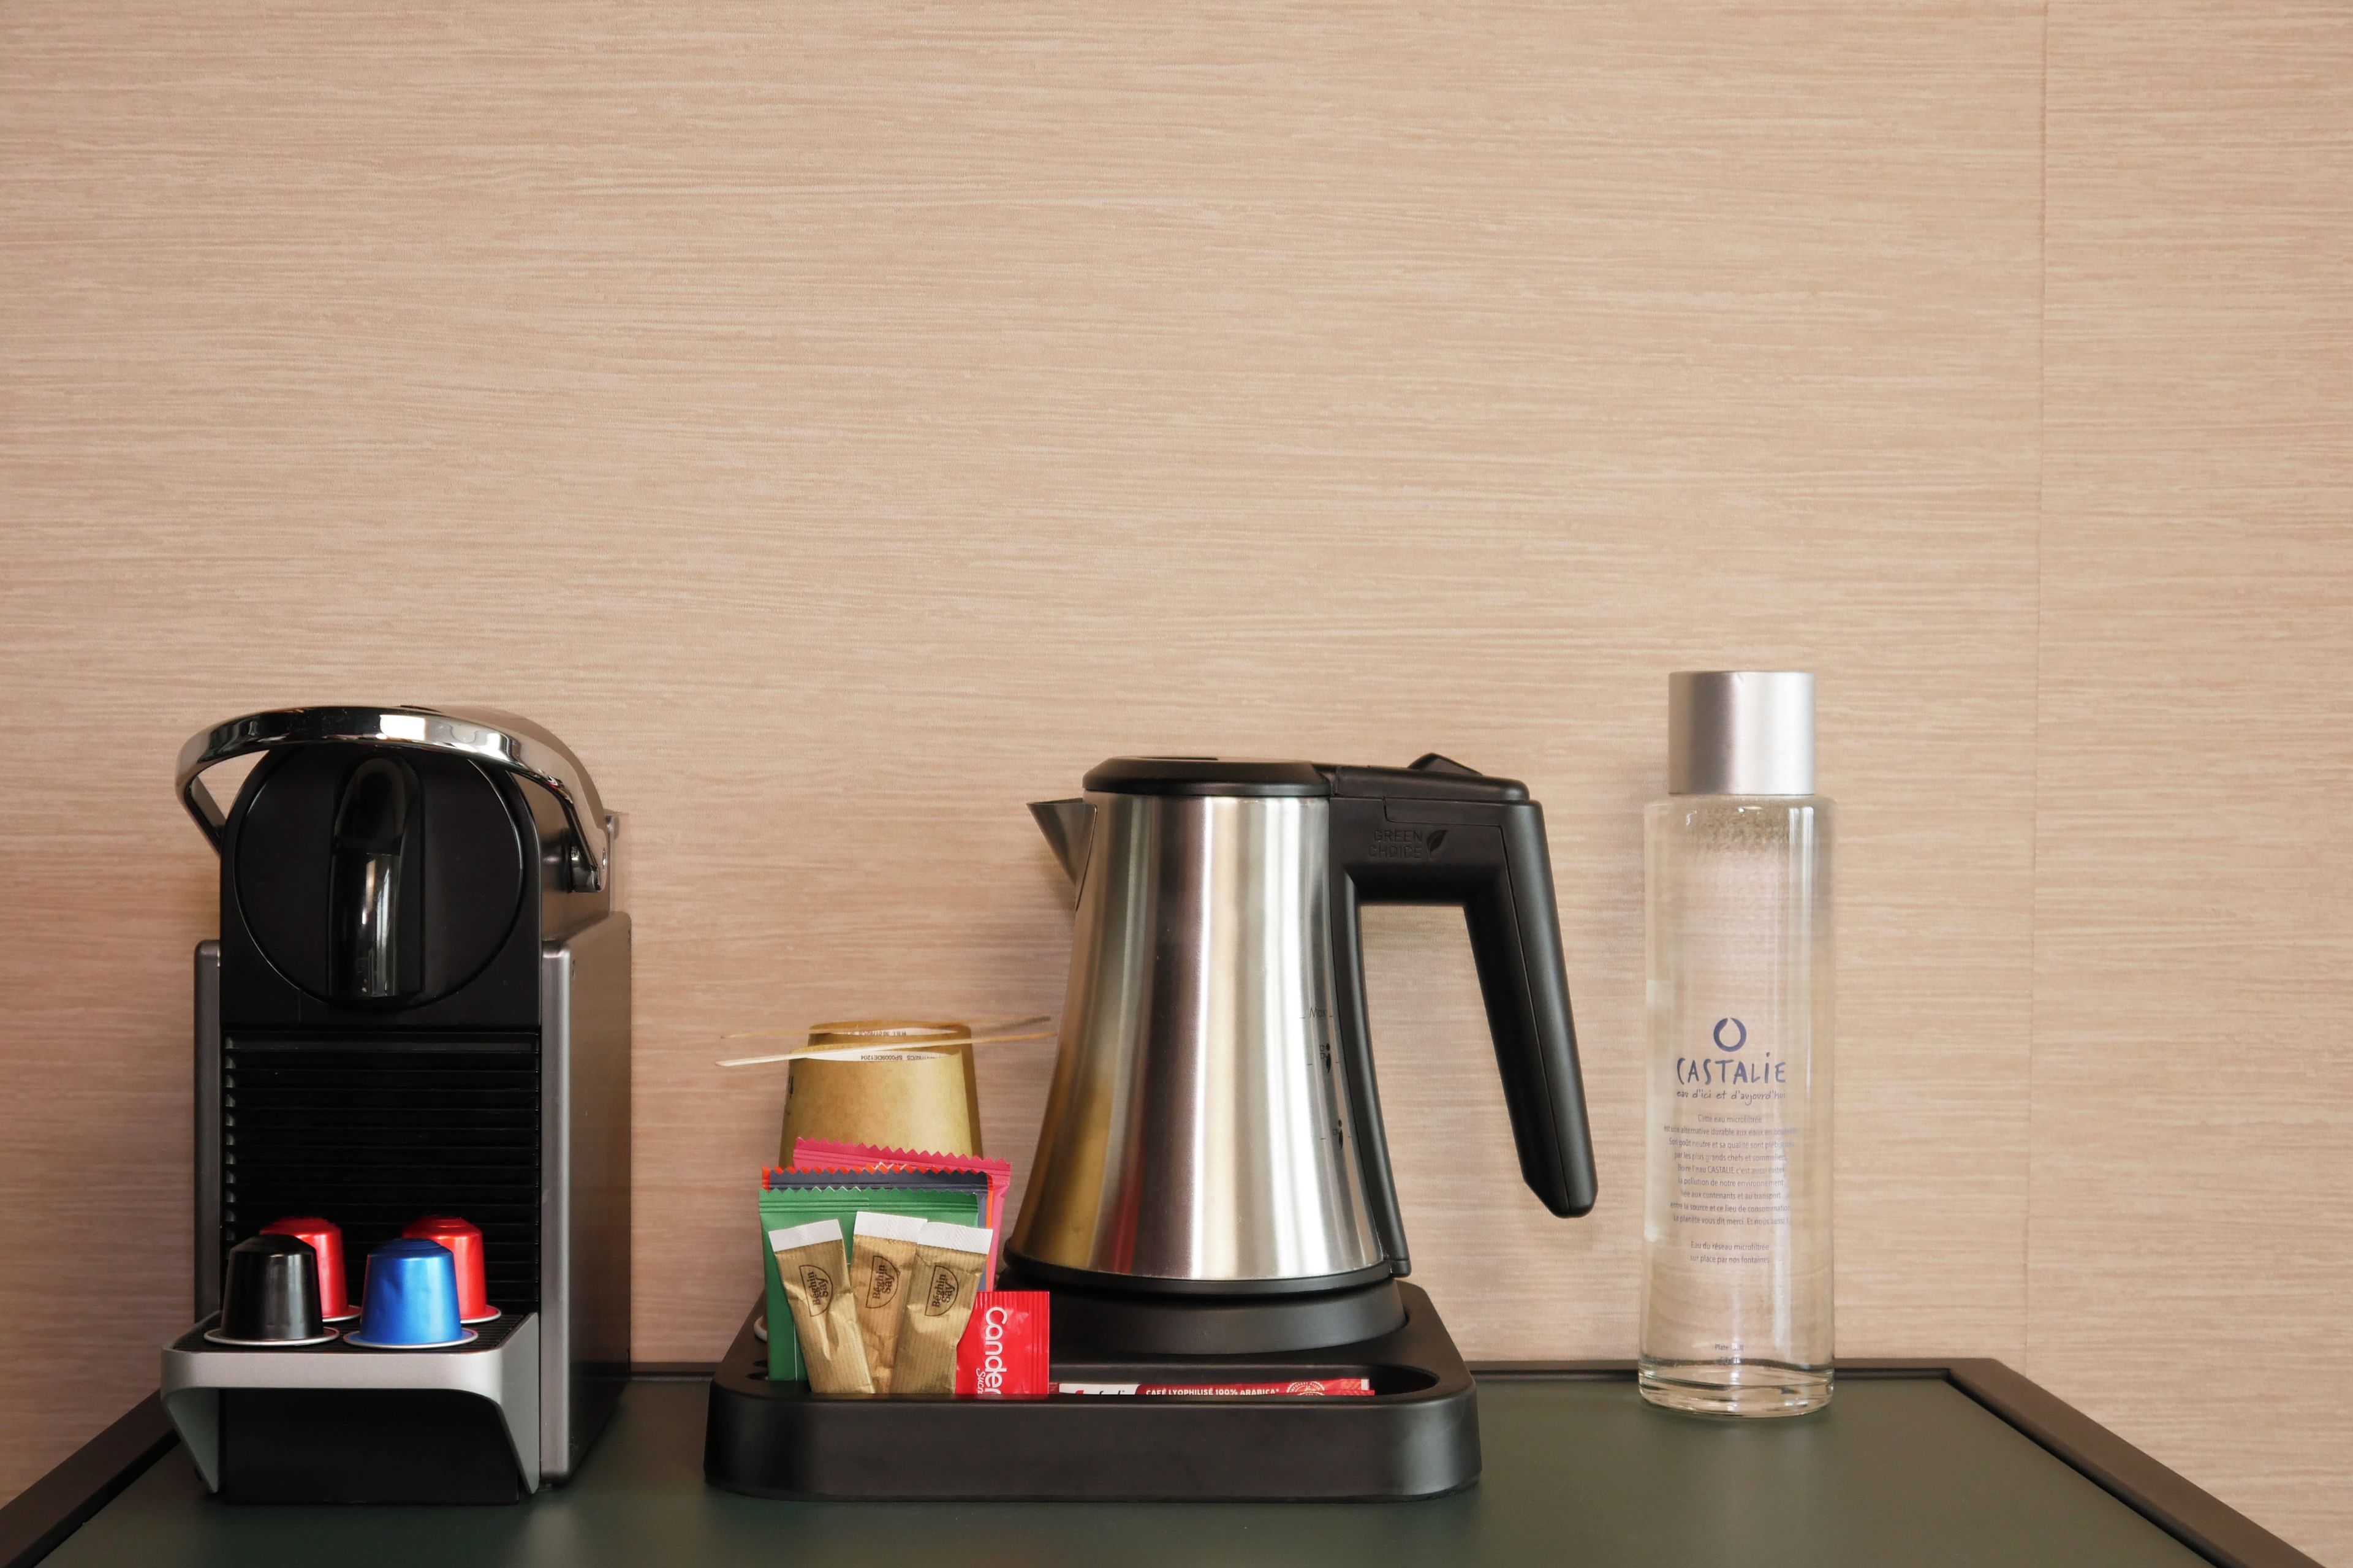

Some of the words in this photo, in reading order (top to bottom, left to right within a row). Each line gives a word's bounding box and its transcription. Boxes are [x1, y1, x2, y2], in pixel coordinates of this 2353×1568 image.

[1374, 830, 1423, 843] GREEN
[1368, 845, 1423, 858] CHOICE
[1716, 1090, 1727, 1099] et
[1681, 1126, 1710, 1135] alternative
[1727, 1141, 1749, 1149] qualité
[1692, 1153, 1704, 1161] plus
[1706, 1154, 1726, 1162] grands
[1684, 1177, 1710, 1186] pollution
[1681, 1189, 1690, 1197] liée
[1680, 1214, 1700, 1223] planète
[1700, 1255, 1716, 1263] place
[814, 1273, 829, 1298] Say
[872, 1264, 885, 1300] Béghin
[882, 1269, 895, 1295] Say
[807, 1271, 820, 1305] Béghin
[931, 1273, 947, 1308] Béghin
[941, 1278, 955, 1303] Say
